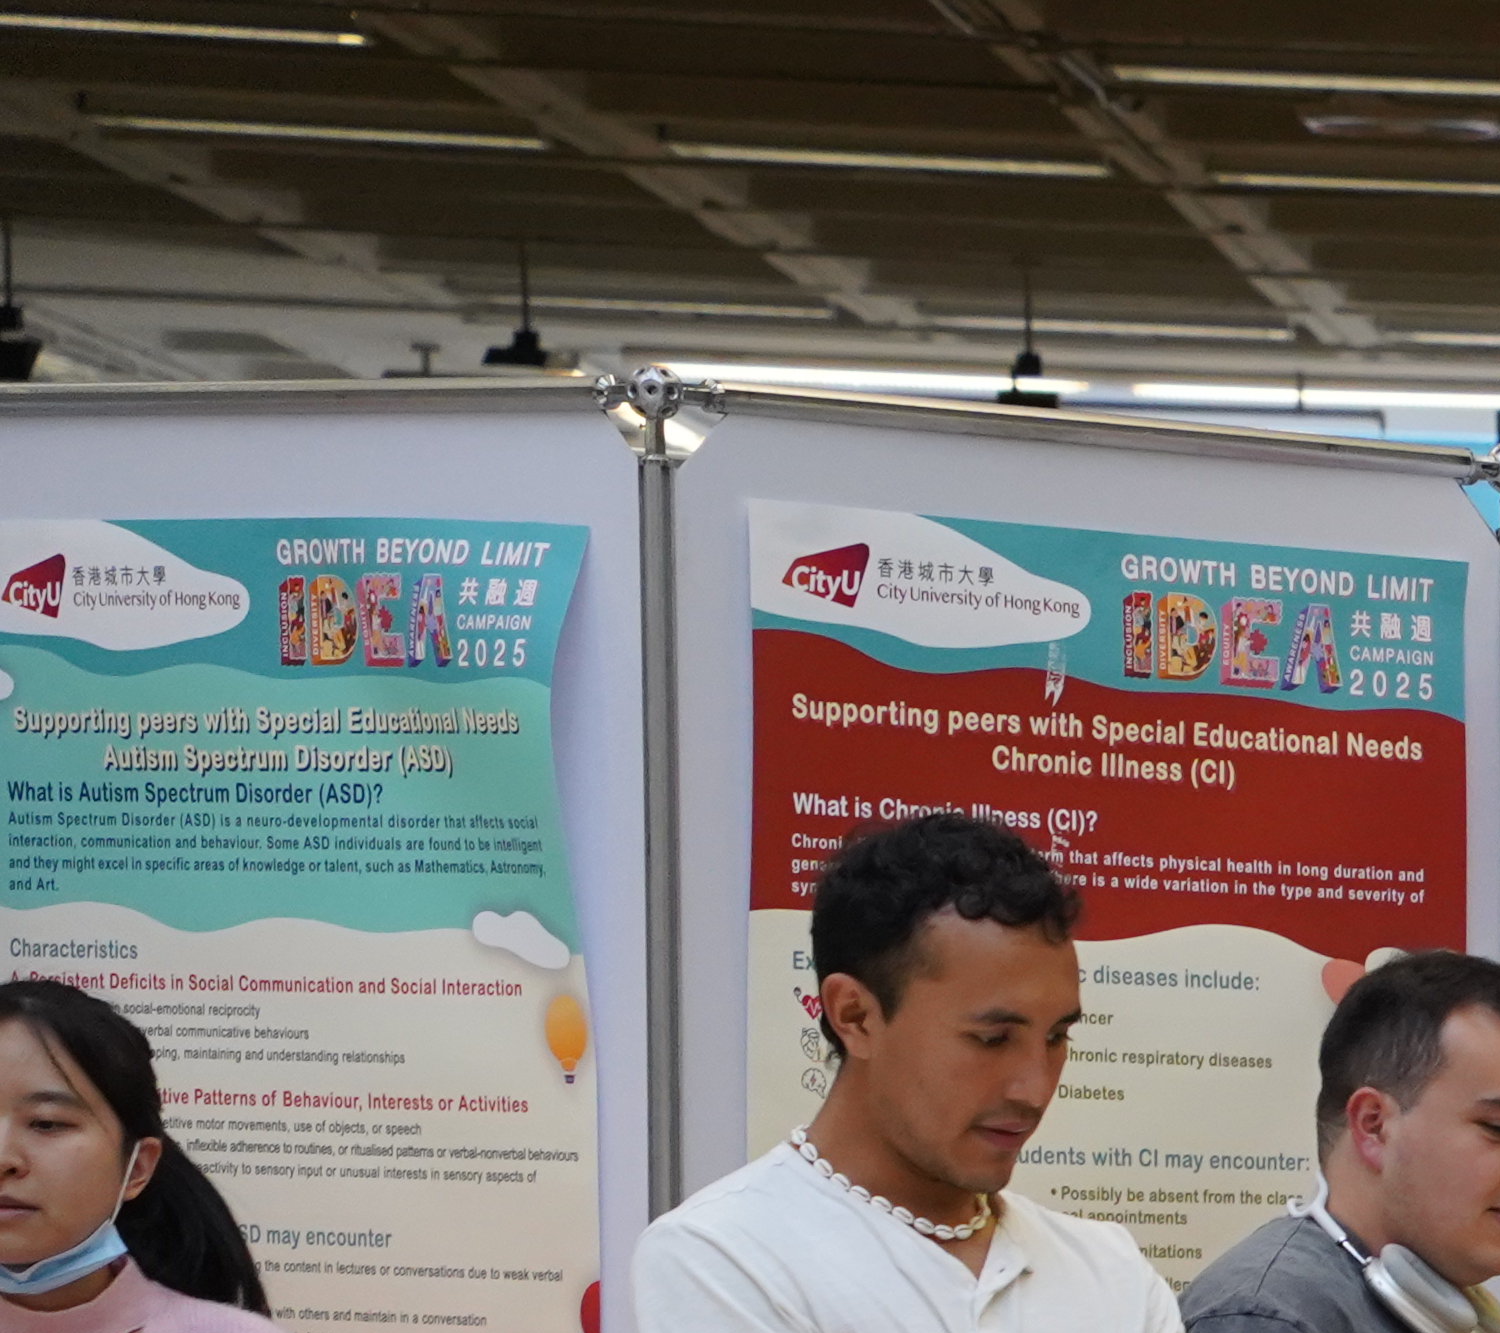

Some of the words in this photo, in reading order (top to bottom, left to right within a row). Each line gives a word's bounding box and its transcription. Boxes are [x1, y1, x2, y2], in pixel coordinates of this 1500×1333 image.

[277, 538, 364, 565] GROWTH
[377, 537, 469, 564] BEYOND
[481, 541, 550, 566] LIMIT
[72, 565, 167, 586] 香港城市大學
[9, 582, 60, 616] CityU
[14, 706, 133, 736] Supporting
[137, 711, 195, 735] peers
[203, 706, 247, 731] with
[256, 706, 338, 736] Special
[347, 707, 457, 731] Educational
[462, 707, 517, 732] Needs
[792, 694, 938, 733] Supporting
[948, 710, 1020, 735] peers
[1029, 709, 1082, 738] with
[1092, 715, 1184, 745] Special
[1194, 722, 1337, 755] Educational
[1347, 732, 1422, 760] Needs
[104, 745, 175, 768] Autism
[183, 744, 285, 773] Spectrum
[295, 744, 390, 769] Disorder
[398, 744, 450, 775] (ASD)
[992, 745, 1091, 775] Chronic
[1102, 752, 1182, 781] Illness
[1191, 759, 1234, 790] (CI)
[8, 811, 52, 826] Autism
[58, 812, 116, 828] Spectrum
[122, 812, 175, 826] Disorder
[180, 813, 215, 830] (ASD)
[221, 814, 230, 828] is
[236, 816, 241, 827] a
[247, 814, 382, 829] neuro-developmental
[388, 814, 440, 829] disorder
[444, 815, 466, 829] that
[470, 814, 504, 829] affects
[508, 815, 538, 829] social
[10, 939, 138, 959] Characteristics
[1093, 965, 1178, 987] diseases
[1184, 970, 1260, 990] include:
